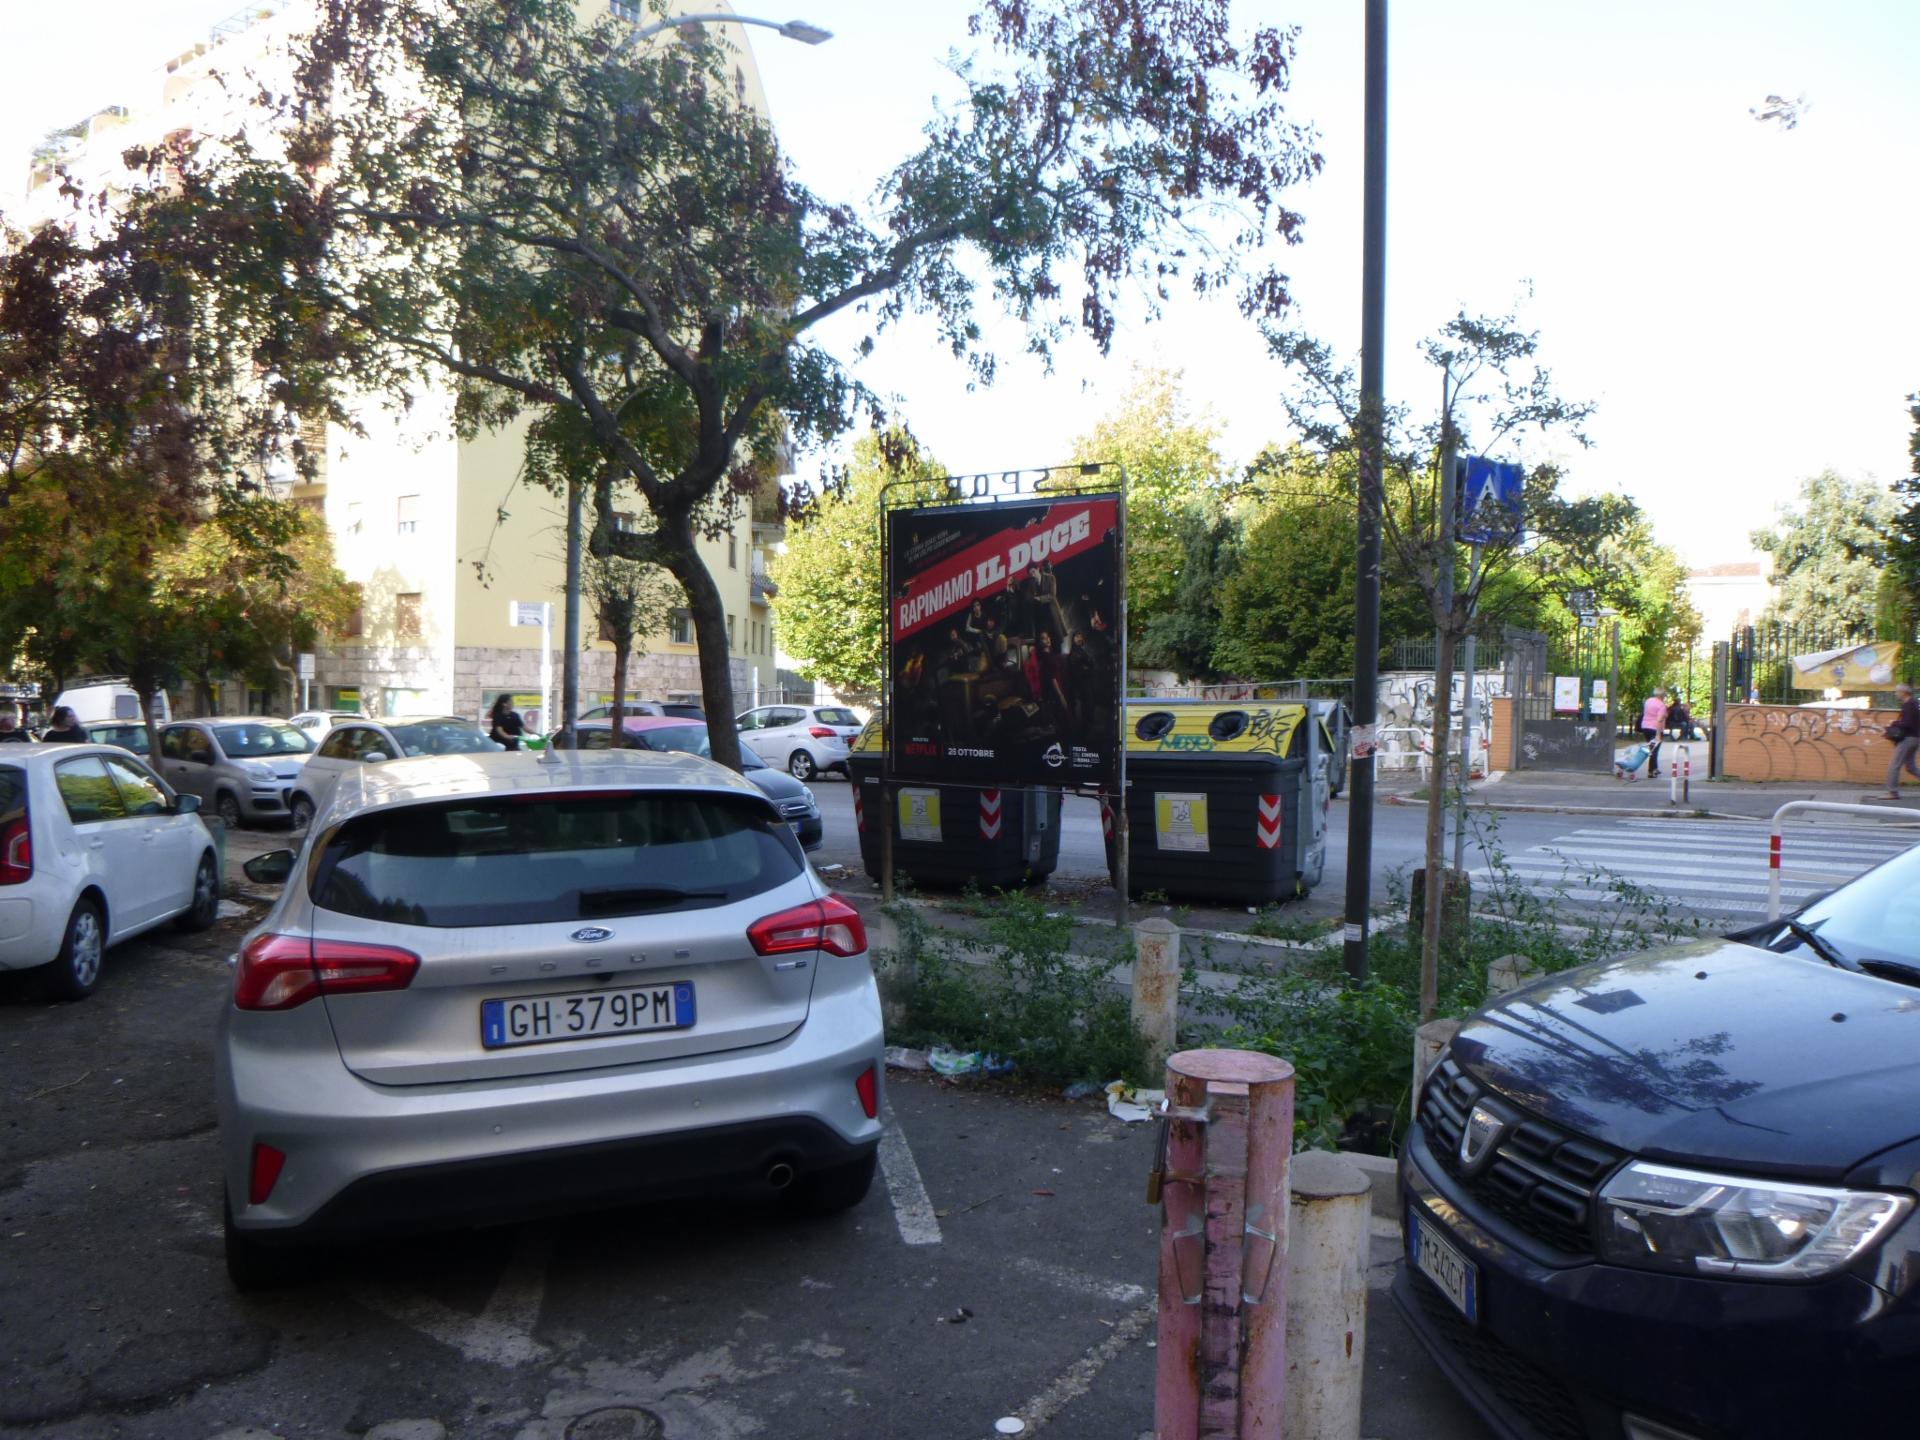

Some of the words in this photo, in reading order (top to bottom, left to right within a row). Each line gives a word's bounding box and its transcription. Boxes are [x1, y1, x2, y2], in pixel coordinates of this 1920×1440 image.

[900, 569, 972, 630] RAPINIAMO
[976, 554, 1006, 591] IL
[1008, 510, 1090, 575] DUCE
[957, 748, 995, 758] OTTOBRE
[577, 929, 605, 940] Ford
[490, 948, 691, 976] FOCUS
[566, 990, 671, 1032] 379PM
